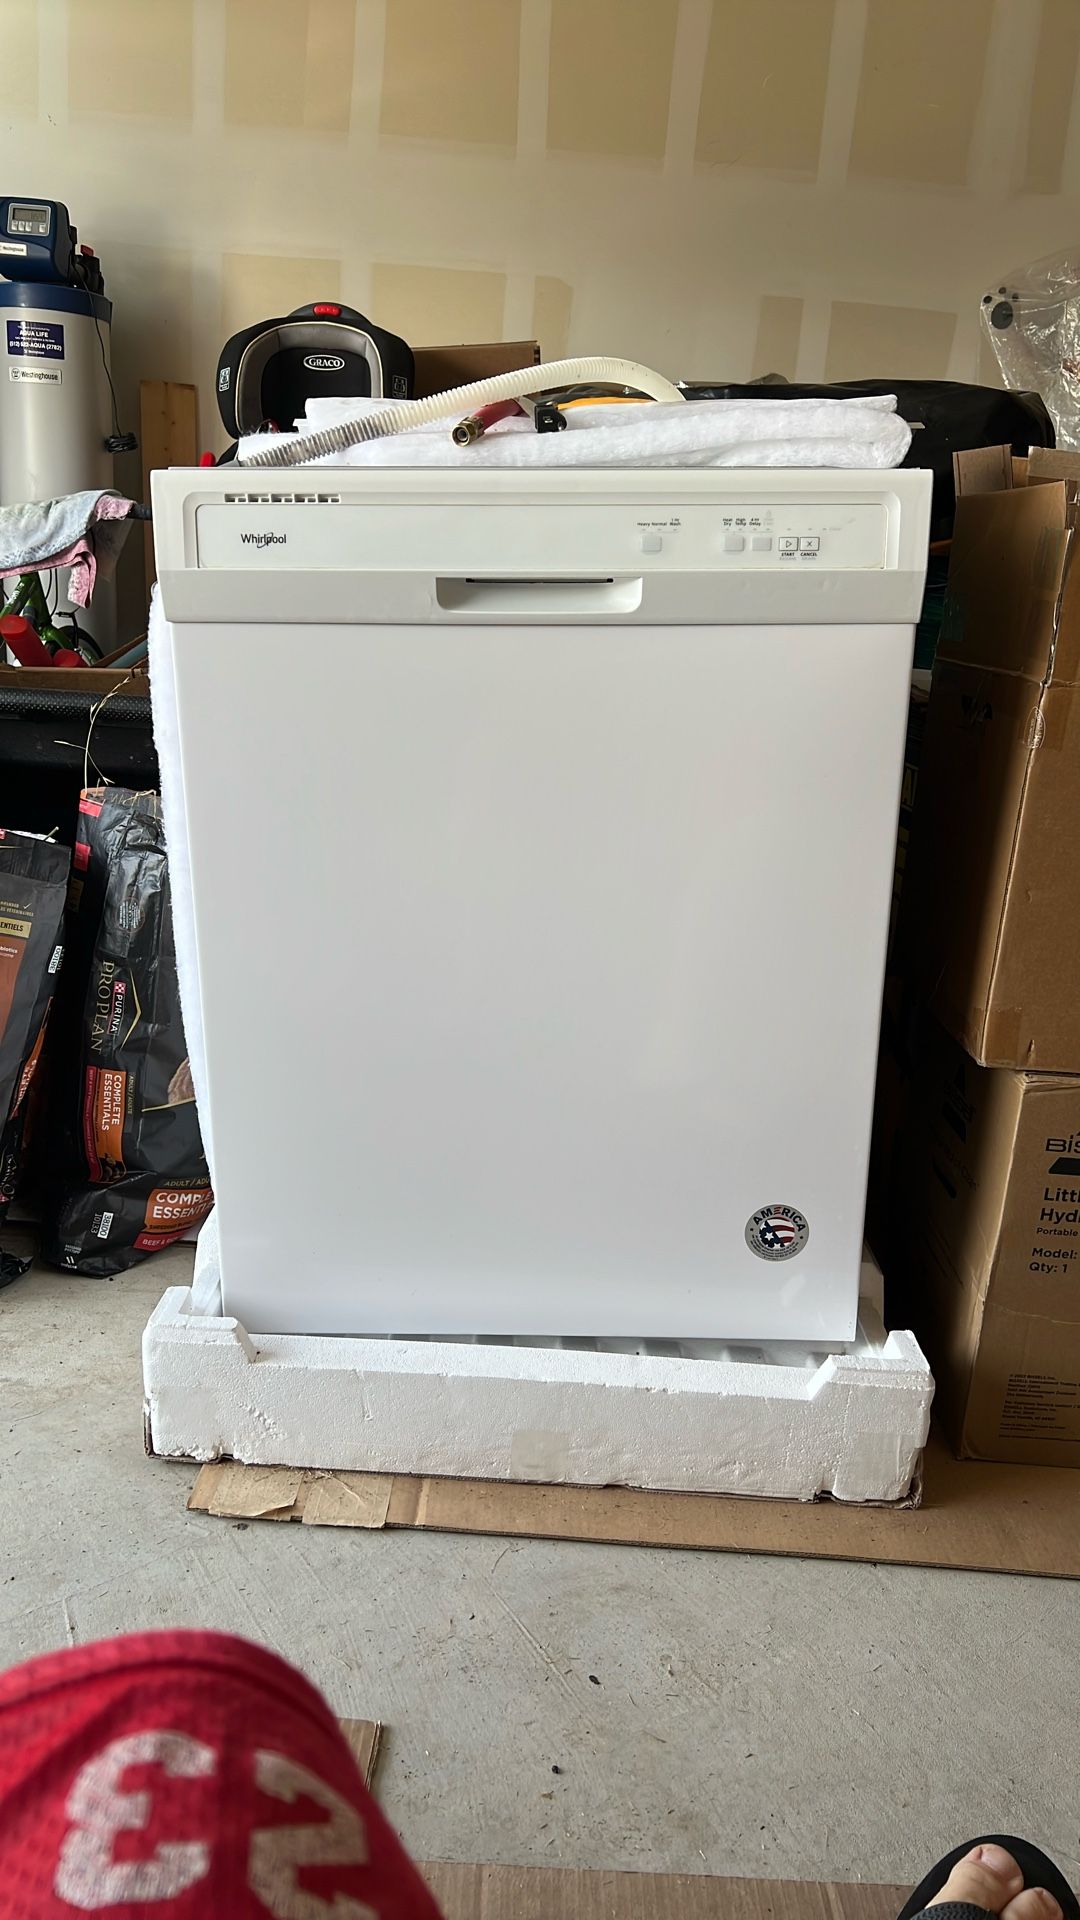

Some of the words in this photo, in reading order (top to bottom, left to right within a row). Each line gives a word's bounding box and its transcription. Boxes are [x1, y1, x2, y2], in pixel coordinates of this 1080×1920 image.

[308, 357, 341, 368] GRACO
[21, 370, 59, 381] Westinghouse
[240, 532, 287, 547] Whirlpool
[97, 959, 115, 999] PRO
[110, 994, 124, 1033] PURINA
[90, 1002, 110, 1050] PLAN
[101, 1073, 113, 1131] ESSENTIALS
[111, 1075, 122, 1126] COMPLETE
[90, 1212, 103, 1234] 10133
[99, 1213, 113, 1237] 38100
[752, 1206, 806, 1232] AMERICA
[1040, 1207, 1080, 1225] Hyd
[1036, 1226, 1079, 1237] Portable
[1031, 1246, 1078, 1260] Model:
[1029, 1261, 1058, 1275] Qty:
[1062, 1263, 1068, 1273] 1
